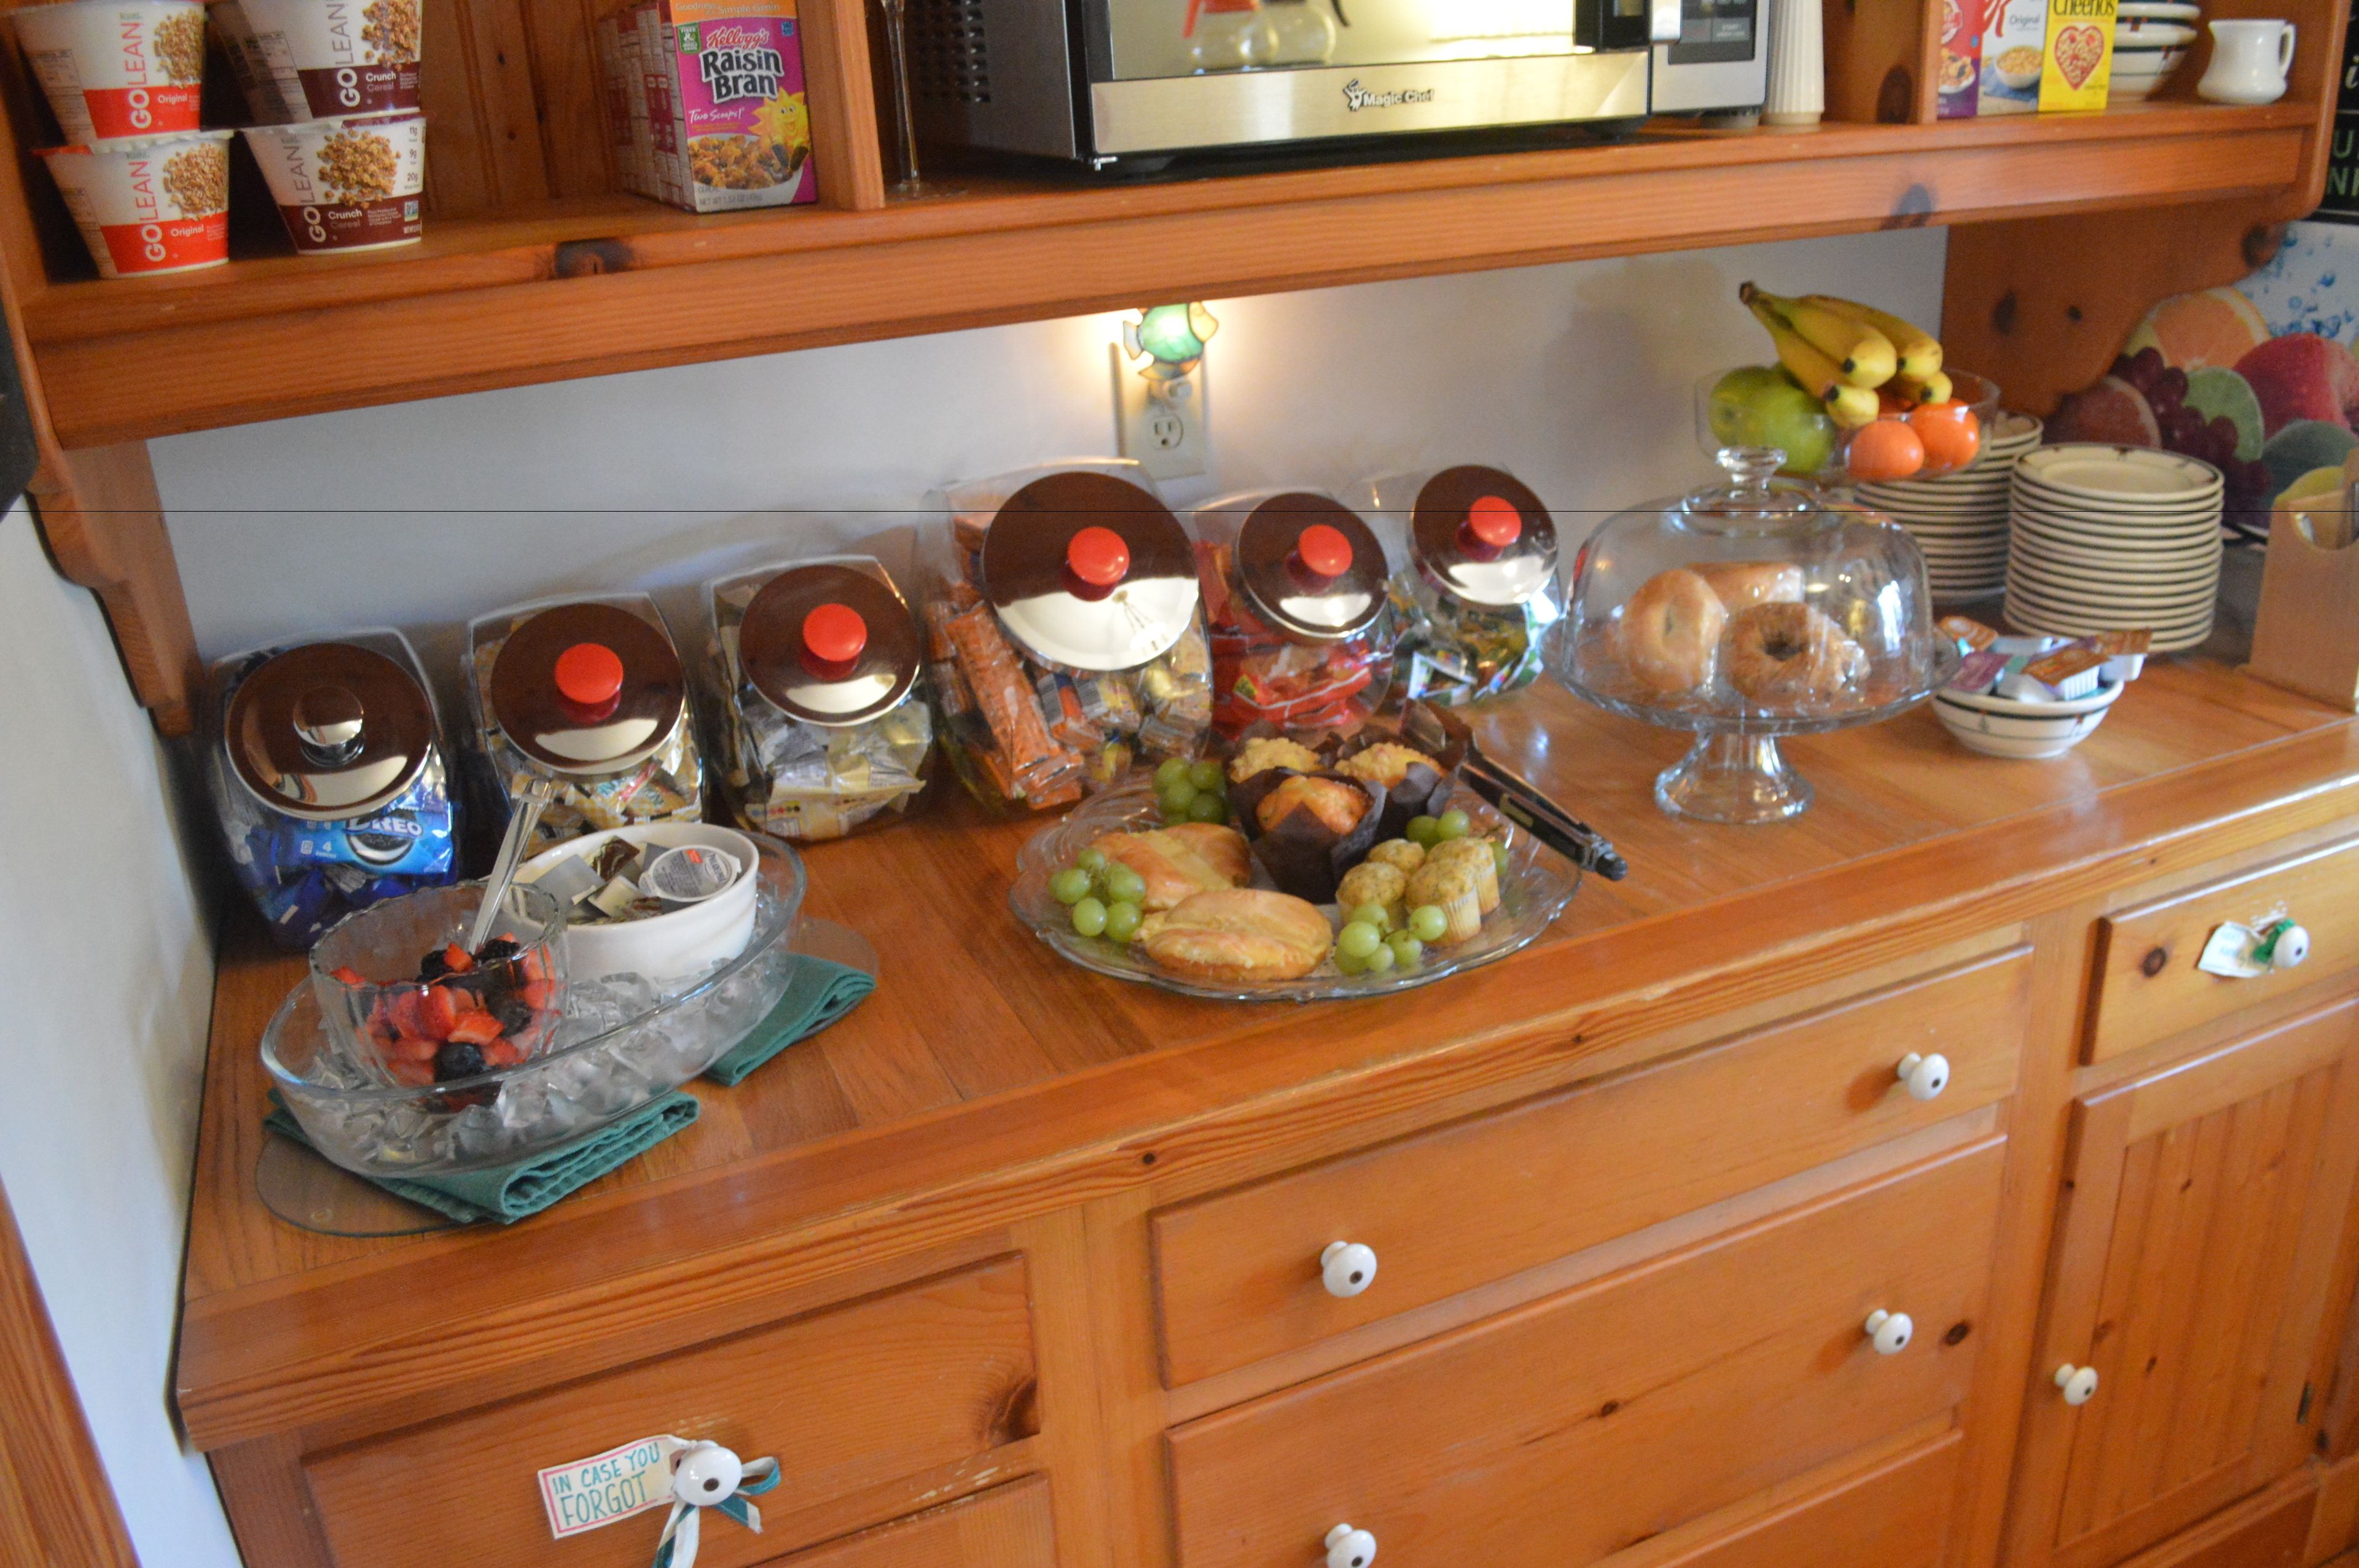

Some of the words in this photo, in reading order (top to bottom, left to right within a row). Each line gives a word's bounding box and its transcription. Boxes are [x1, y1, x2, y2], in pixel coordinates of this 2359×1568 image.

[2009, 14, 2041, 26] Original
[707, 27, 770, 49] Kellogg's
[700, 49, 784, 79] Raisin
[366, 71, 397, 82] Crunch
[714, 74, 777, 101] Bran
[157, 93, 187, 105] Original
[1363, 92, 1402, 107] Magic
[1403, 88, 1435, 103] Chef
[689, 108, 708, 124] Two
[409, 149, 417, 158] 9g
[407, 172, 418, 182] 20g
[328, 209, 362, 220] Crunch
[170, 224, 205, 237] Original
[552, 1474, 571, 1495] IN
[581, 1458, 621, 1488] CASE
[624, 1441, 660, 1469] YOU
[560, 1470, 649, 1527] FORGOT
